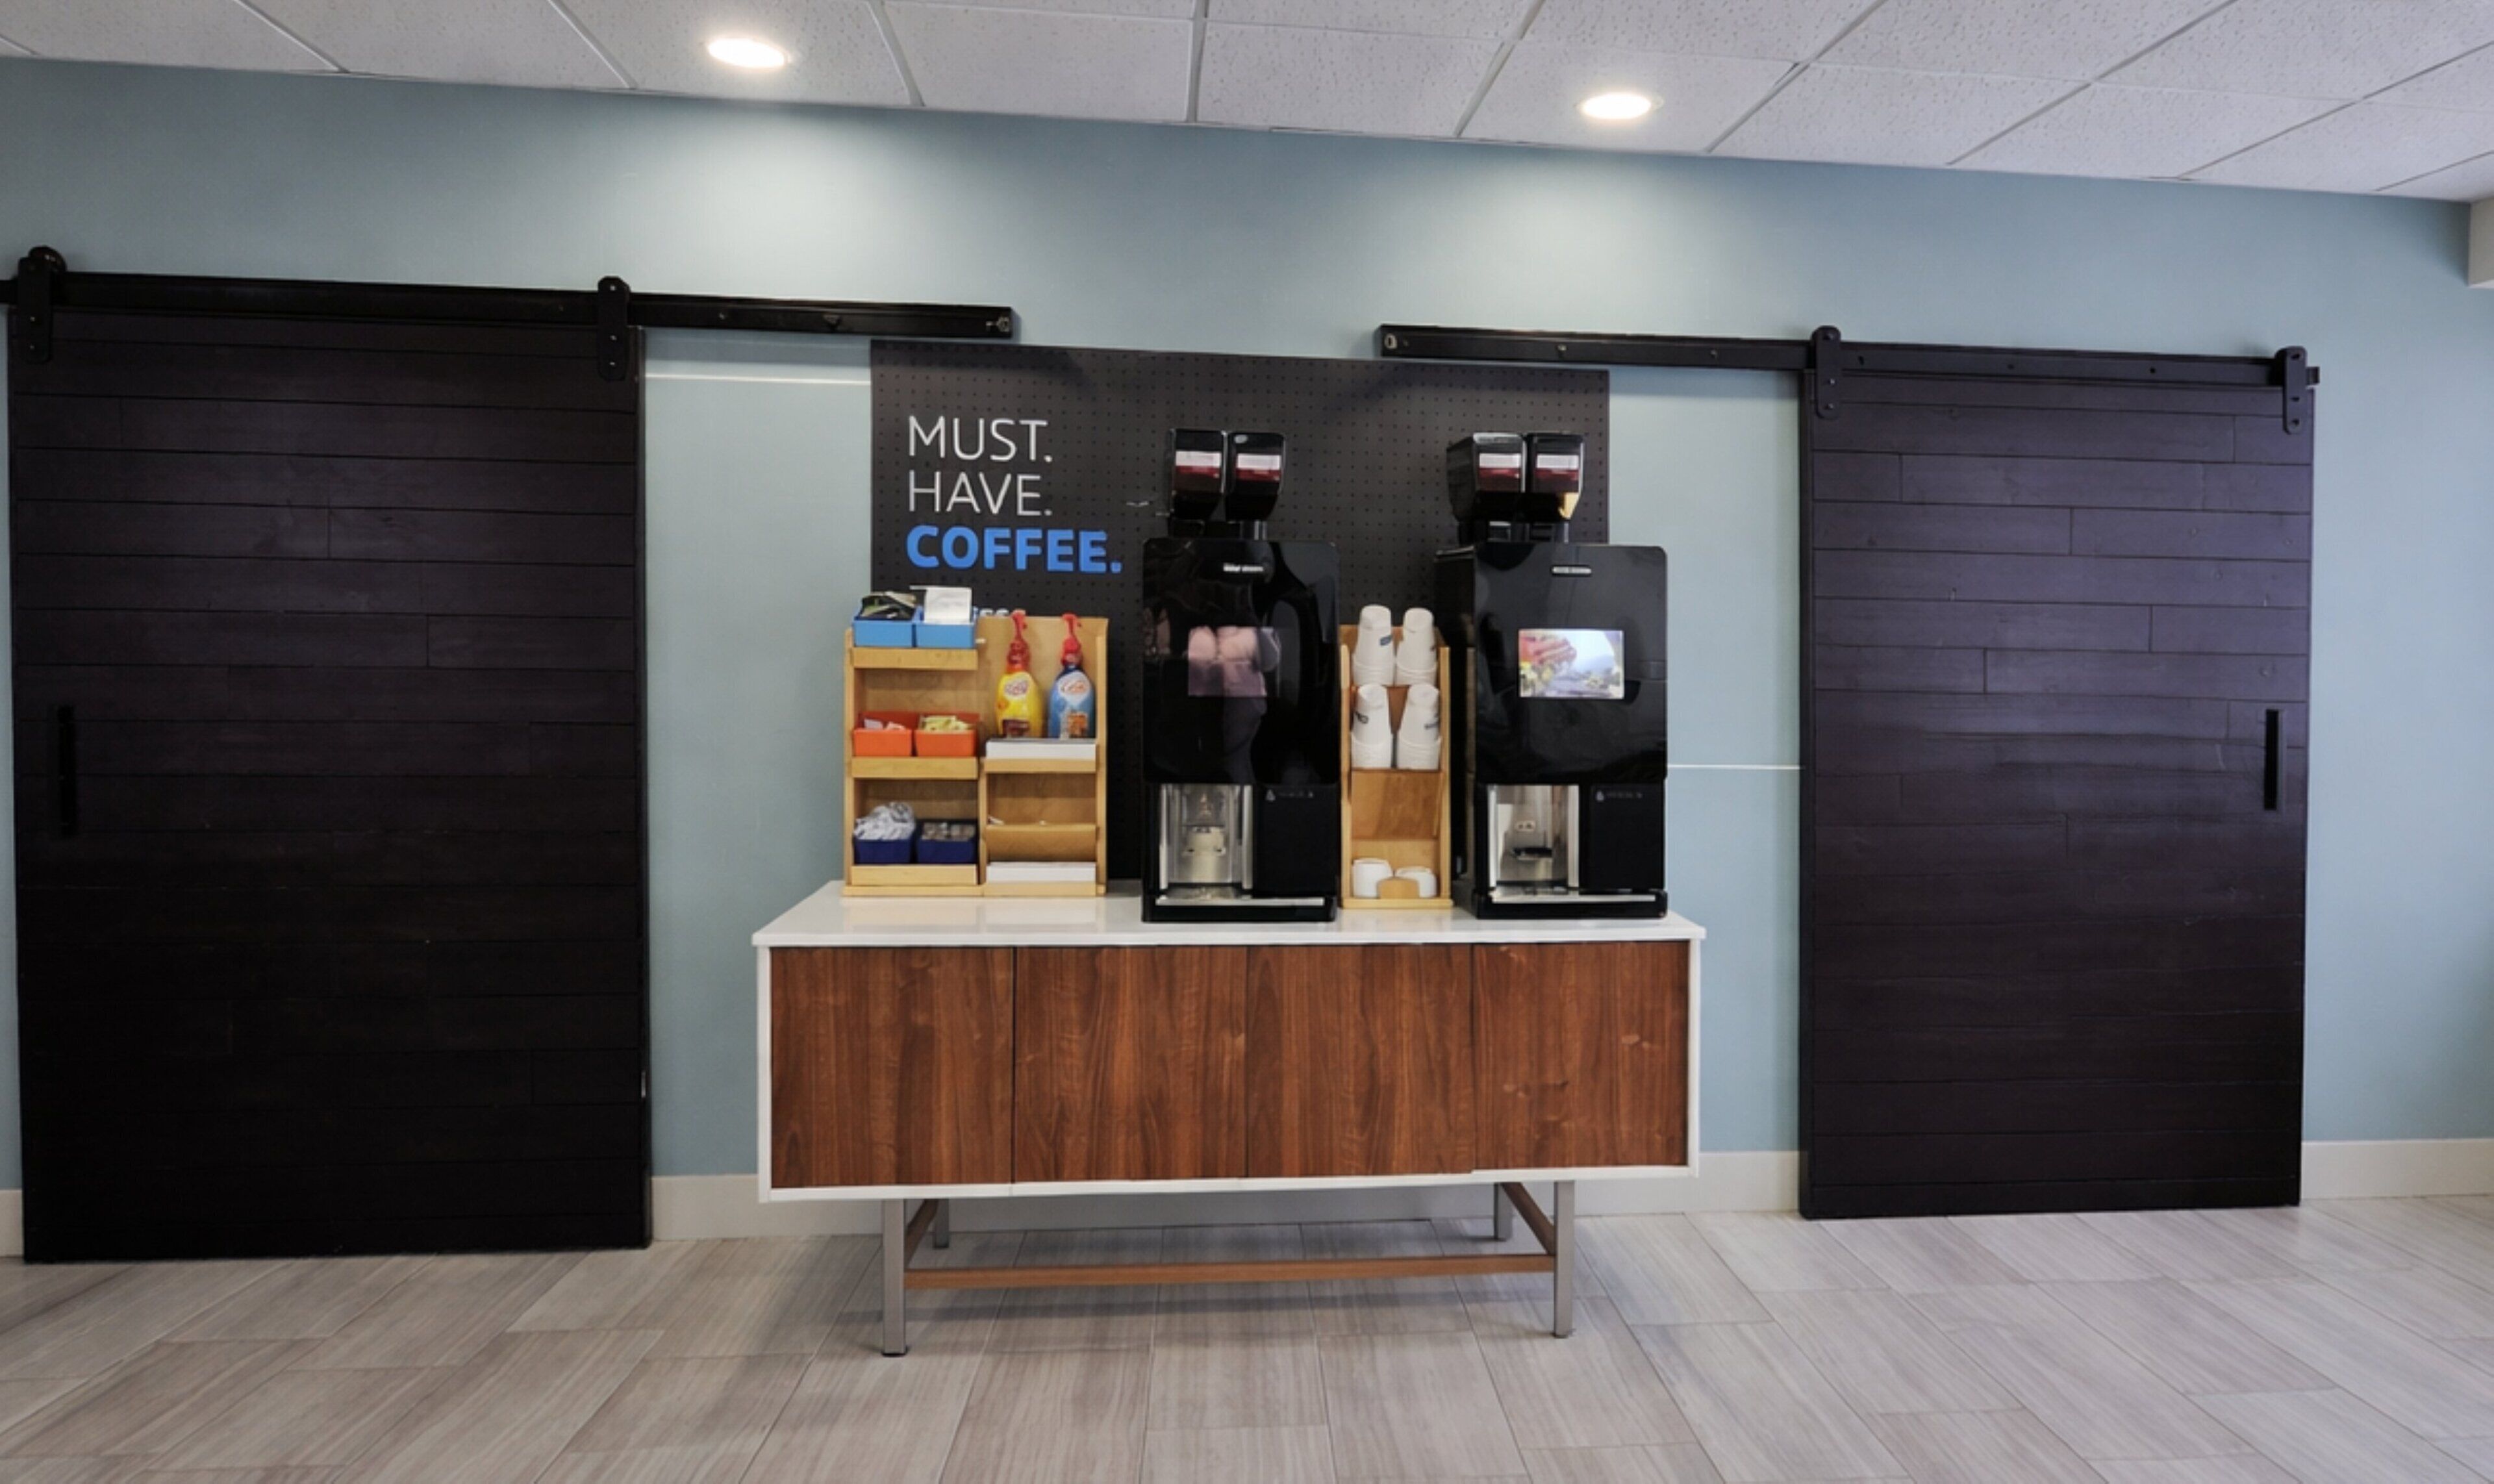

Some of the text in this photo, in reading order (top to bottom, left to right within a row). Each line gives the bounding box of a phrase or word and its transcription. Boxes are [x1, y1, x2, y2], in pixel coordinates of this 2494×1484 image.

[909, 415, 1053, 462] MUST.
[909, 470, 1052, 516] HAVE.
[906, 525, 1122, 573] COFFEE.
